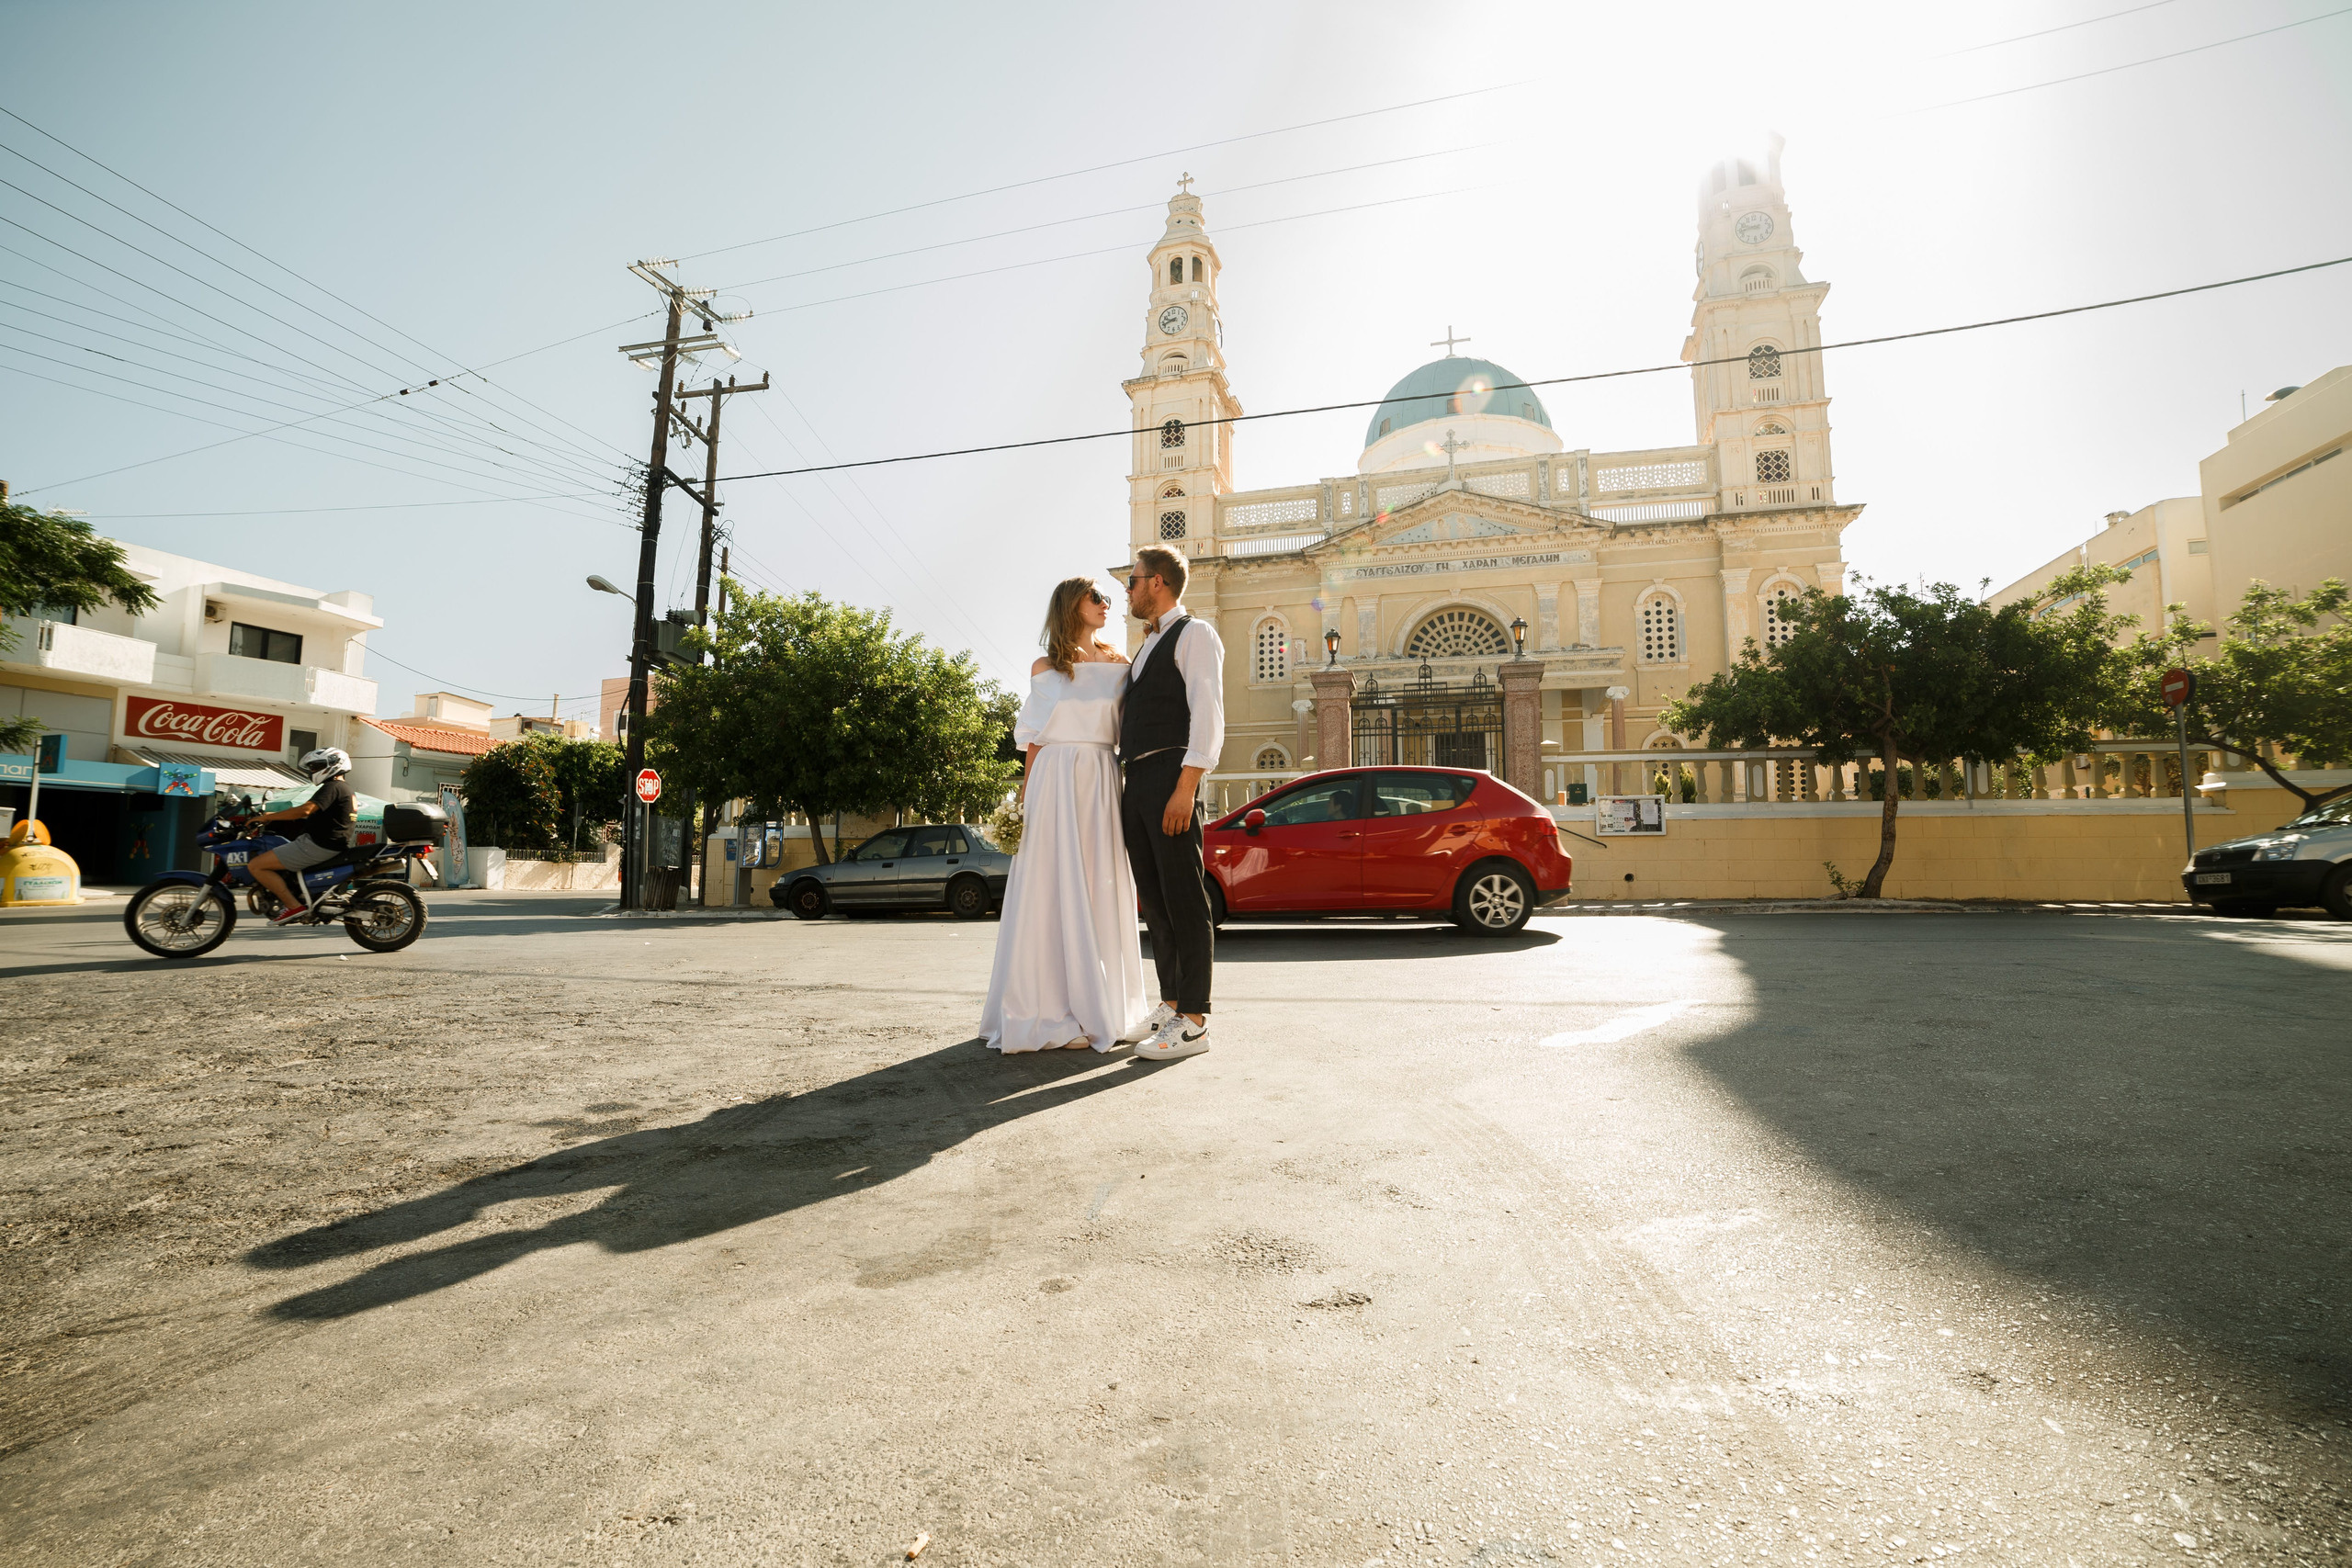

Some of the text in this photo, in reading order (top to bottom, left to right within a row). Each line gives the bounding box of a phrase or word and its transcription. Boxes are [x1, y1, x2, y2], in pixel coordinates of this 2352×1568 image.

[138, 703, 274, 747] Coca-Cola
[639, 777, 659, 795] STOP
[227, 851, 248, 863] AX-1
